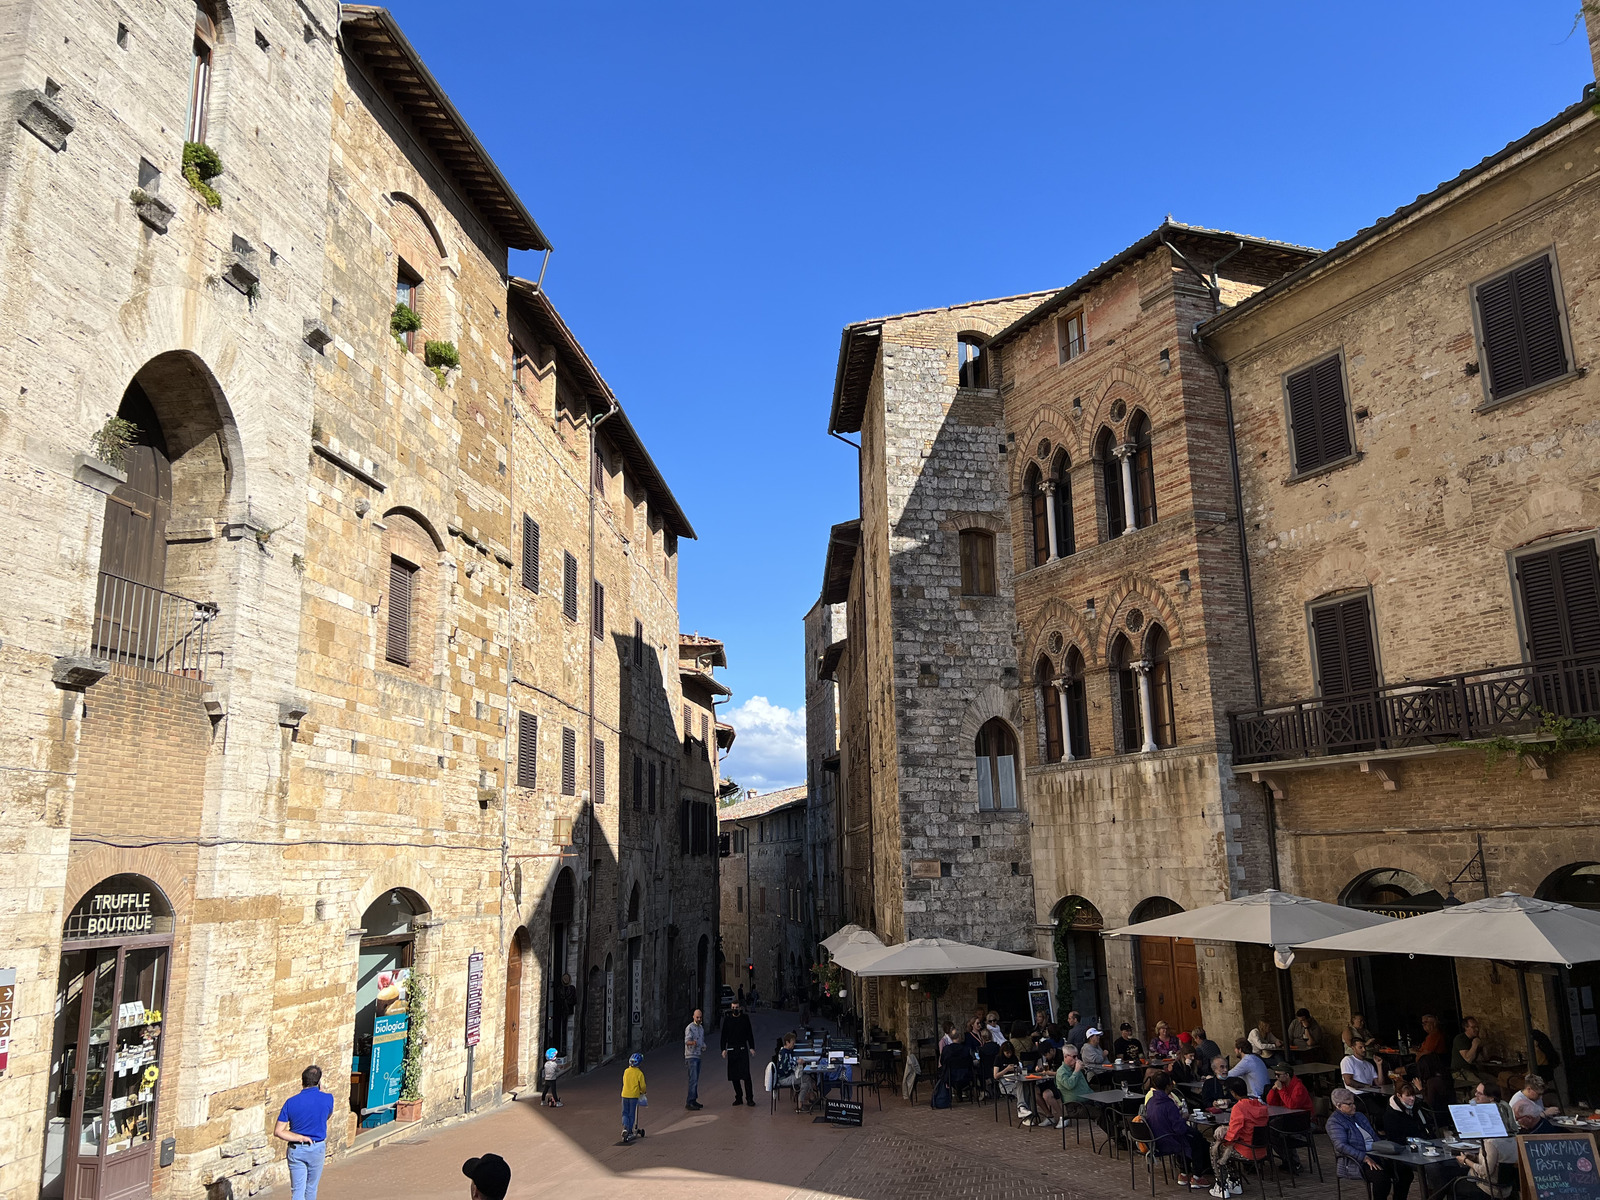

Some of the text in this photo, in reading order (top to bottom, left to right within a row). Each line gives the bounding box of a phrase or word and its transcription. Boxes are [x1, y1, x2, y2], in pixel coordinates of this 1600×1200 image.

[95, 893, 151, 909] TRUFFLE
[88, 915, 152, 933] BOUTIQUE
[375, 1020, 405, 1033] biologica
[1529, 1140, 1590, 1157] HOMEMADE
[1535, 1158, 1565, 1171] PASTA
